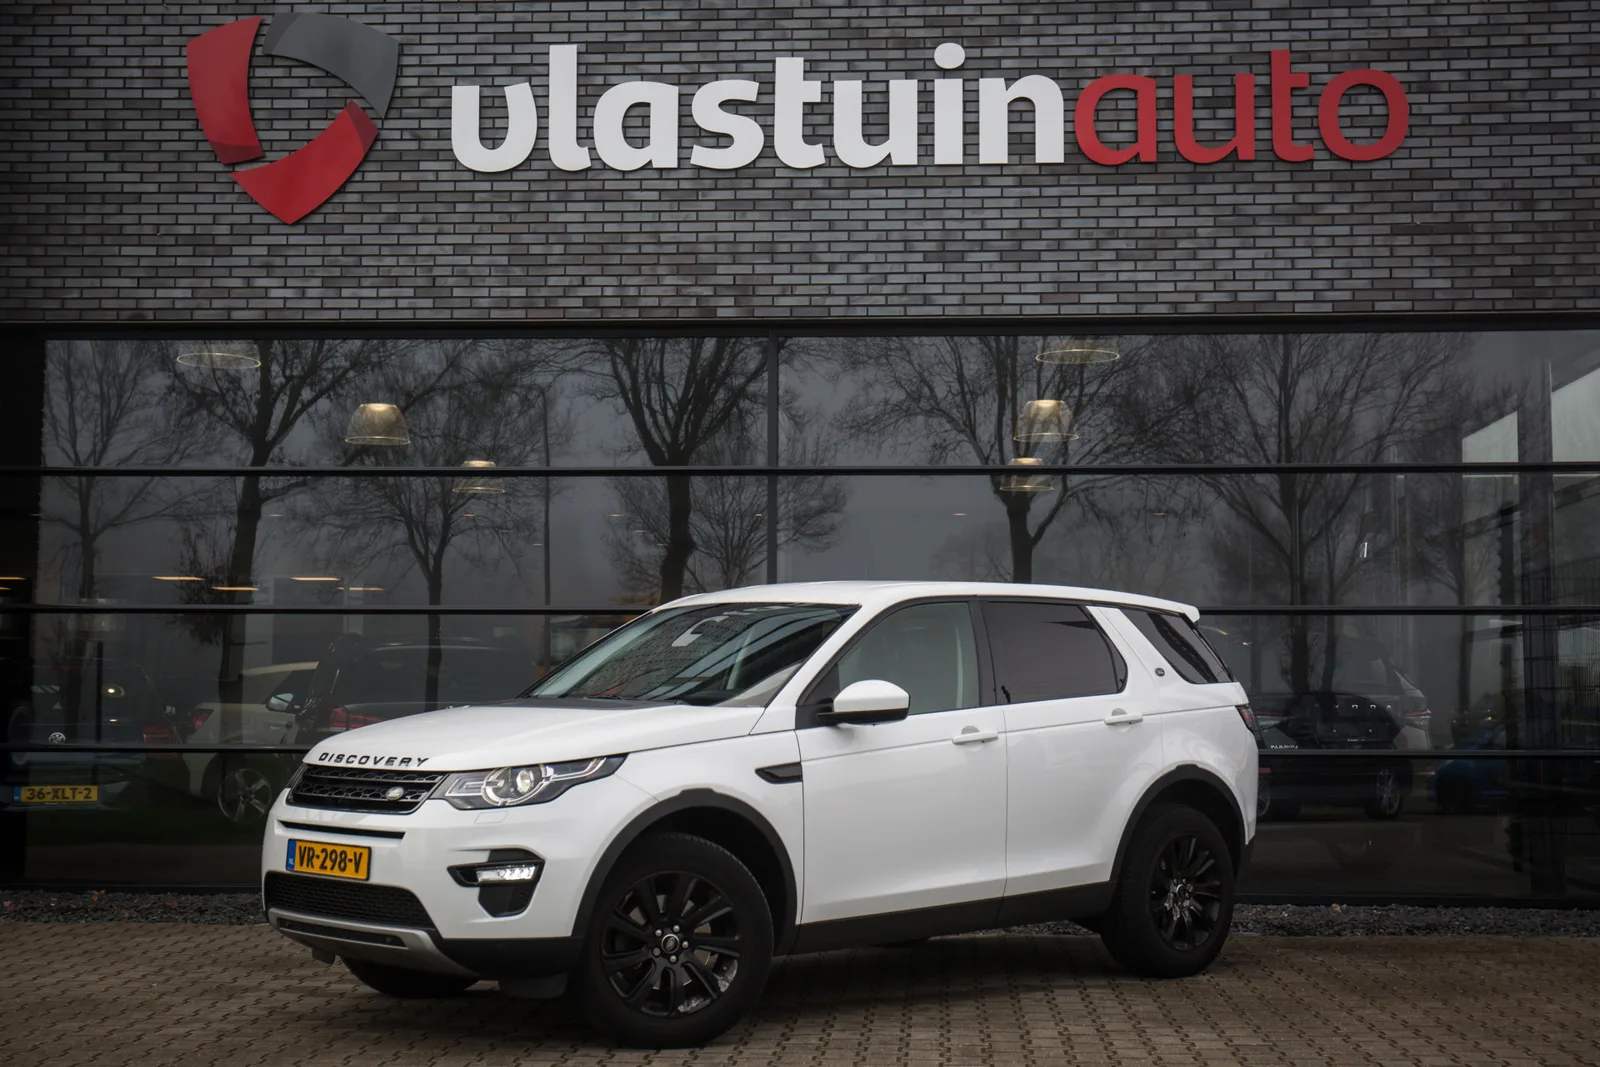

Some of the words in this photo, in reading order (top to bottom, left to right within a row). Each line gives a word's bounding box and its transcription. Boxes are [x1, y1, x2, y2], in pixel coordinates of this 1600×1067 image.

[318, 752, 430, 767] DISCOVERY
[26, 787, 92, 800] 36-XLT-2
[298, 845, 363, 875] VR-298-V
